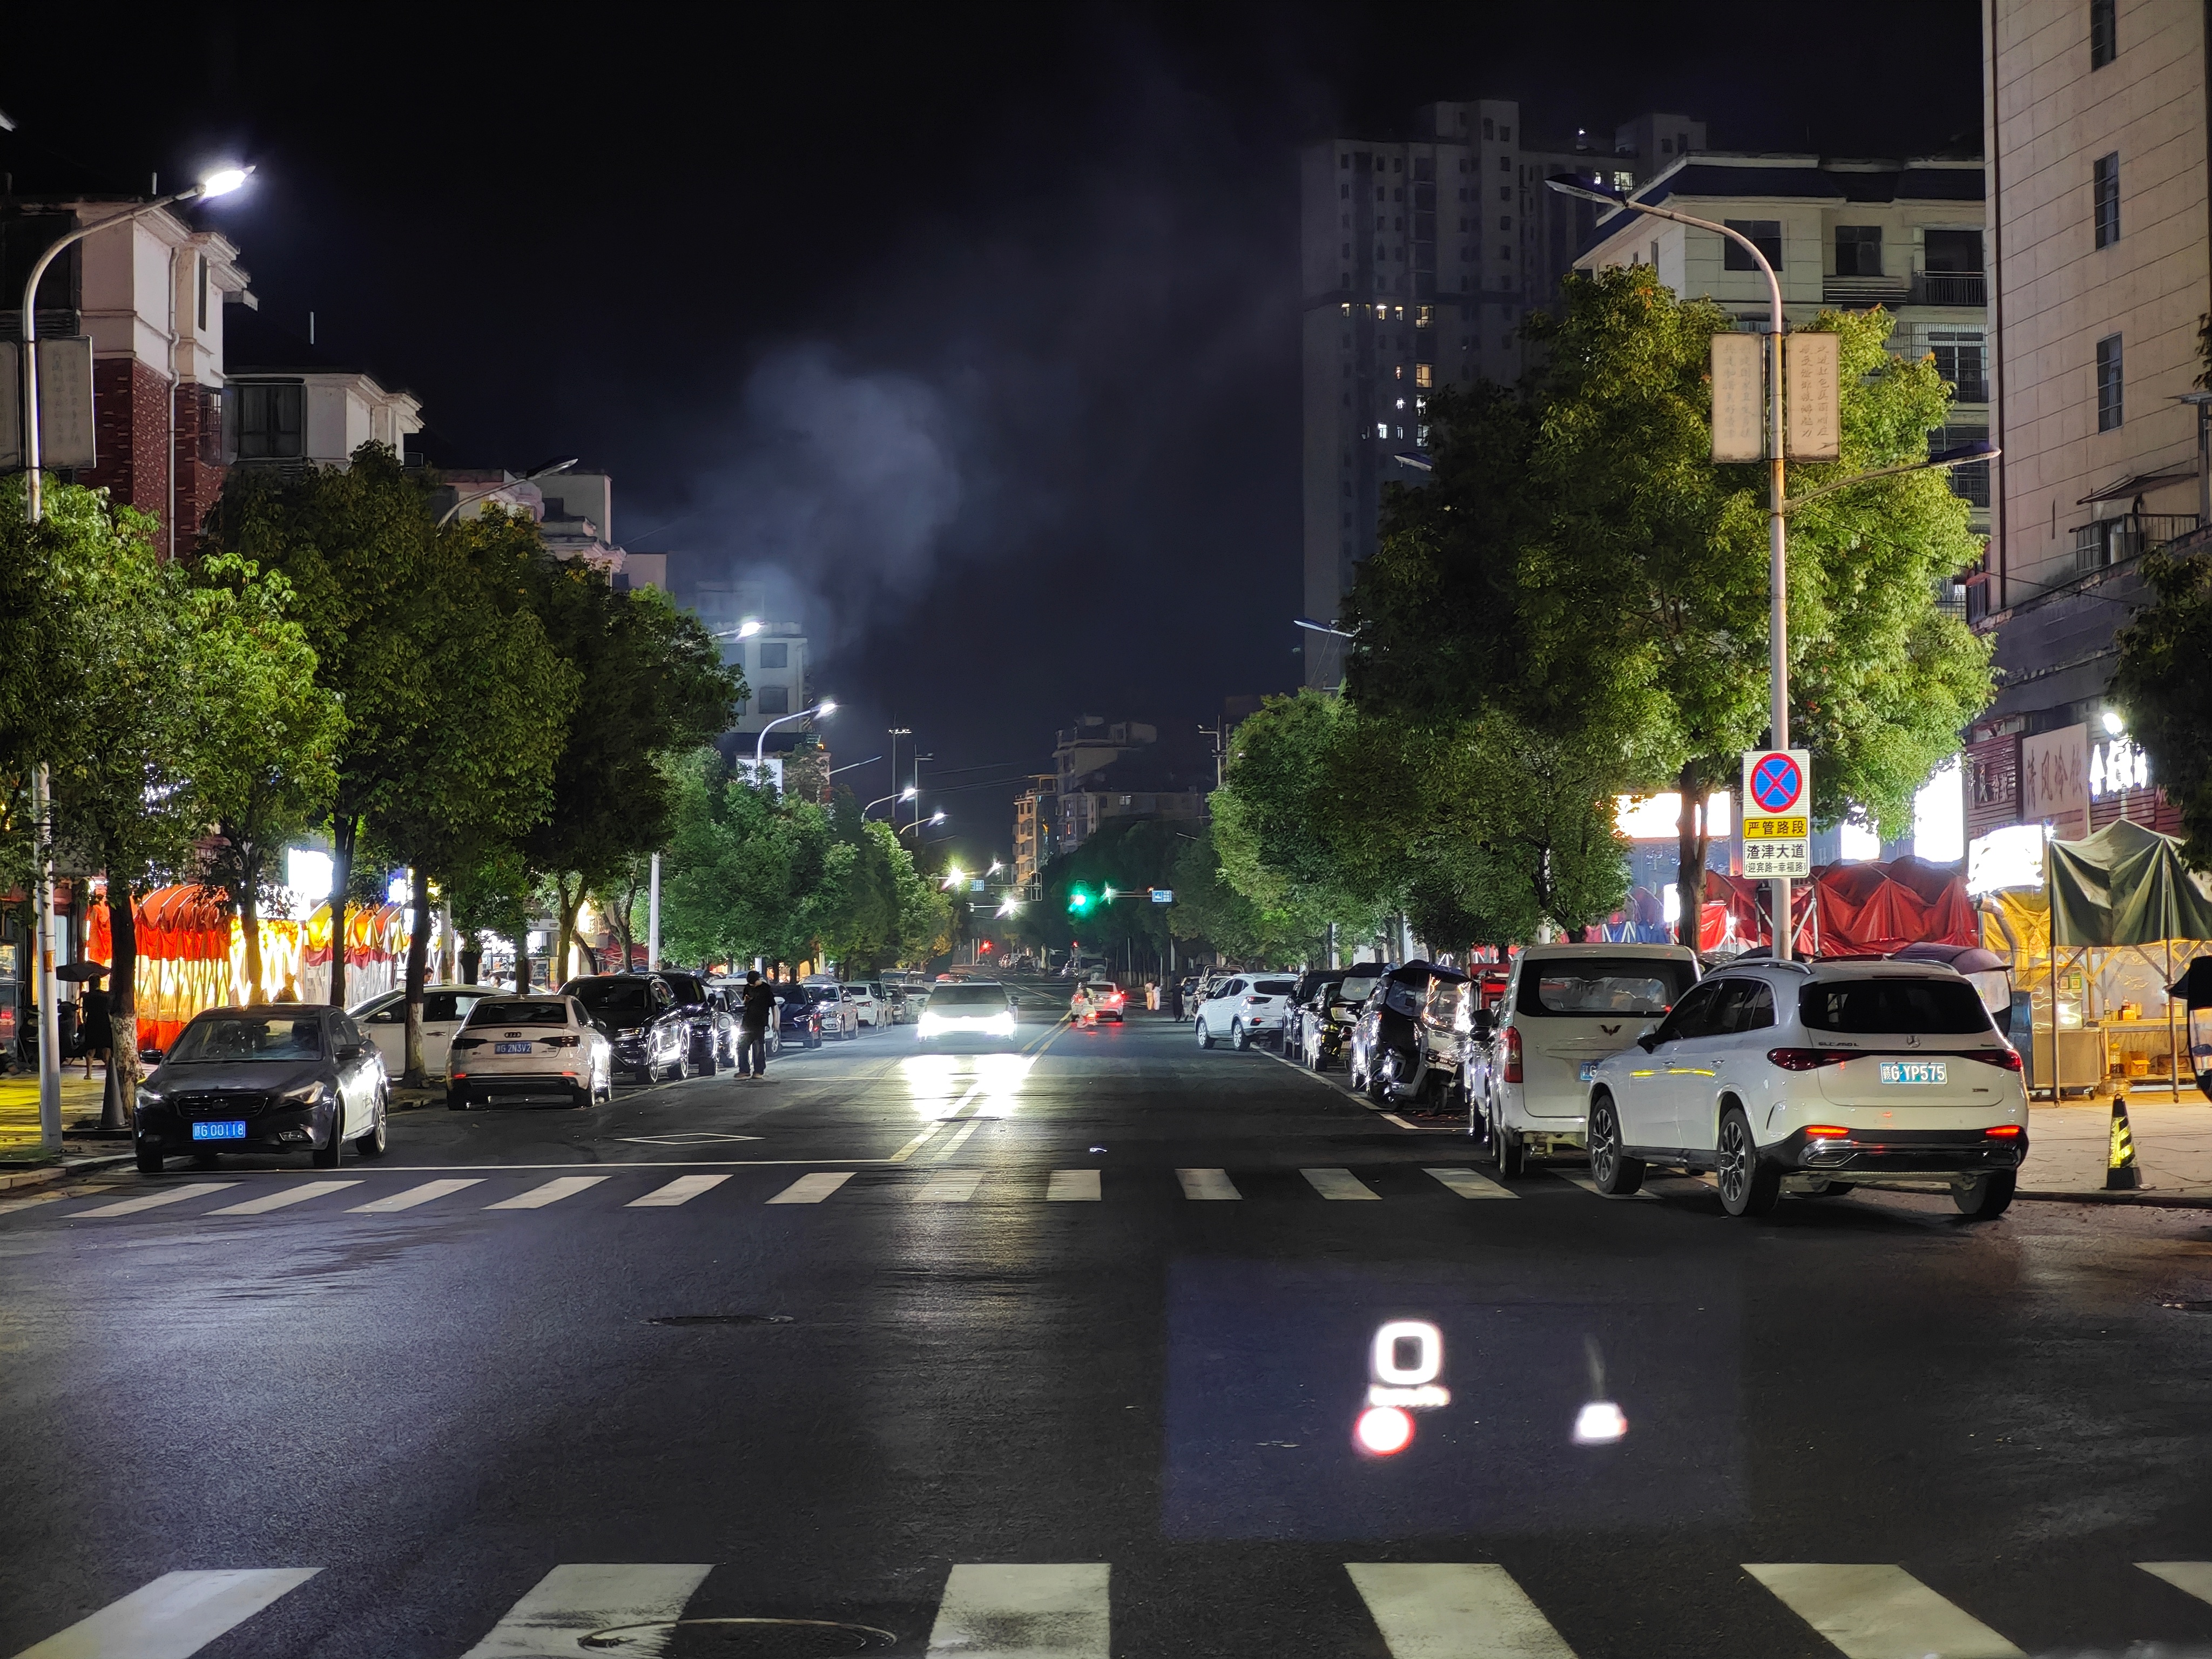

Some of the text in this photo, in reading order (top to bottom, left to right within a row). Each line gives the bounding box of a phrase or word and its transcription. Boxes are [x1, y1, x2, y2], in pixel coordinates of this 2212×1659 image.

[1748, 820, 1804, 835] 严管路段
[1747, 844, 1805, 859] 渣津大道
